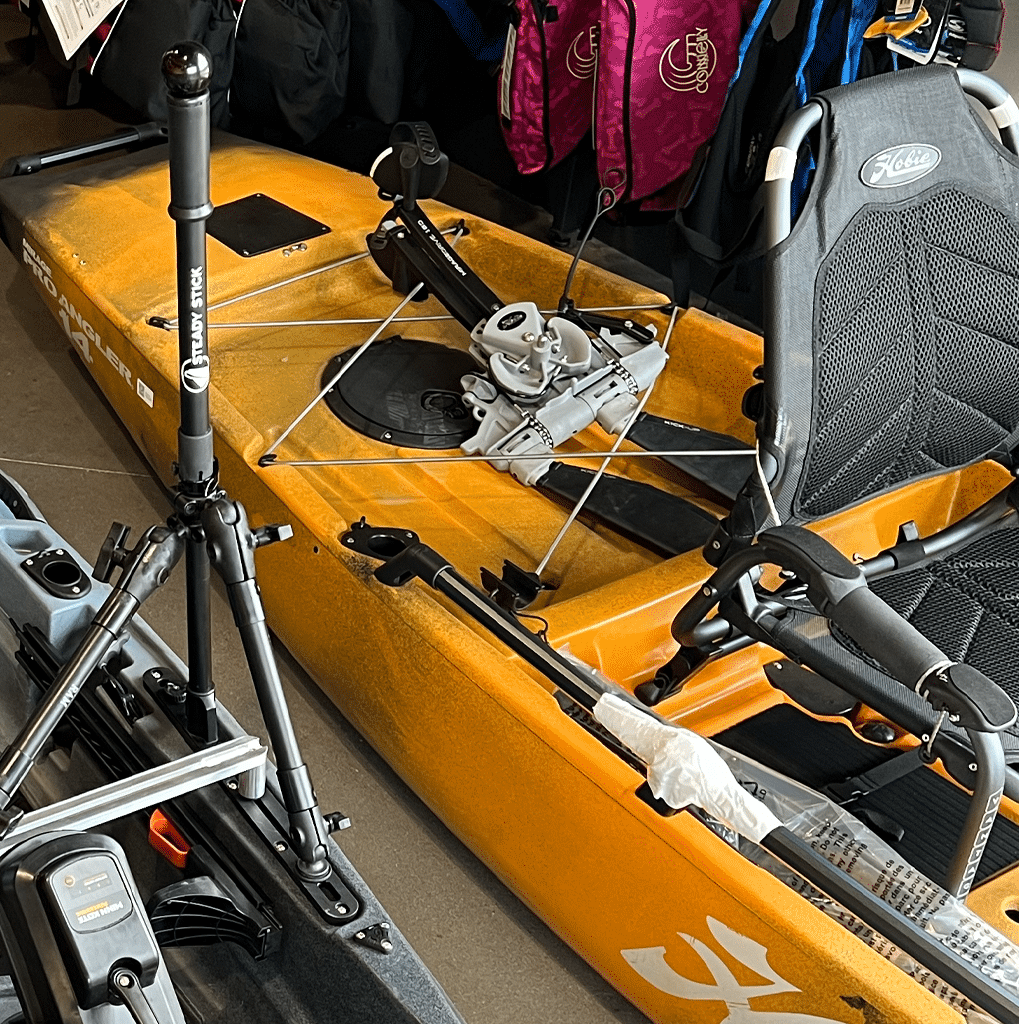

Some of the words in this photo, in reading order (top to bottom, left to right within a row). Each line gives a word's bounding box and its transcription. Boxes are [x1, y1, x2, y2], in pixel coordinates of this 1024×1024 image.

[868, 149, 932, 184] Hobie
[190, 266, 204, 309] STICK
[23, 249, 58, 297] PRO
[58, 294, 132, 386] ANGLER
[59, 308, 91, 363] 14
[190, 312, 204, 366] STEADY
[820, 840, 830, 850] Do
[829, 827, 839, 838] not
[834, 834, 848, 847] This
[963, 796, 1000, 891] VANTAG
[845, 844, 868, 873] emoving
[872, 870, 887, 892] risque
[886, 860, 894, 868] de
[893, 865, 904, 877] des
[891, 882, 905, 899] dans
[905, 871, 913, 879] un
[895, 894, 909, 912] parc
[908, 876, 922, 894] pour
